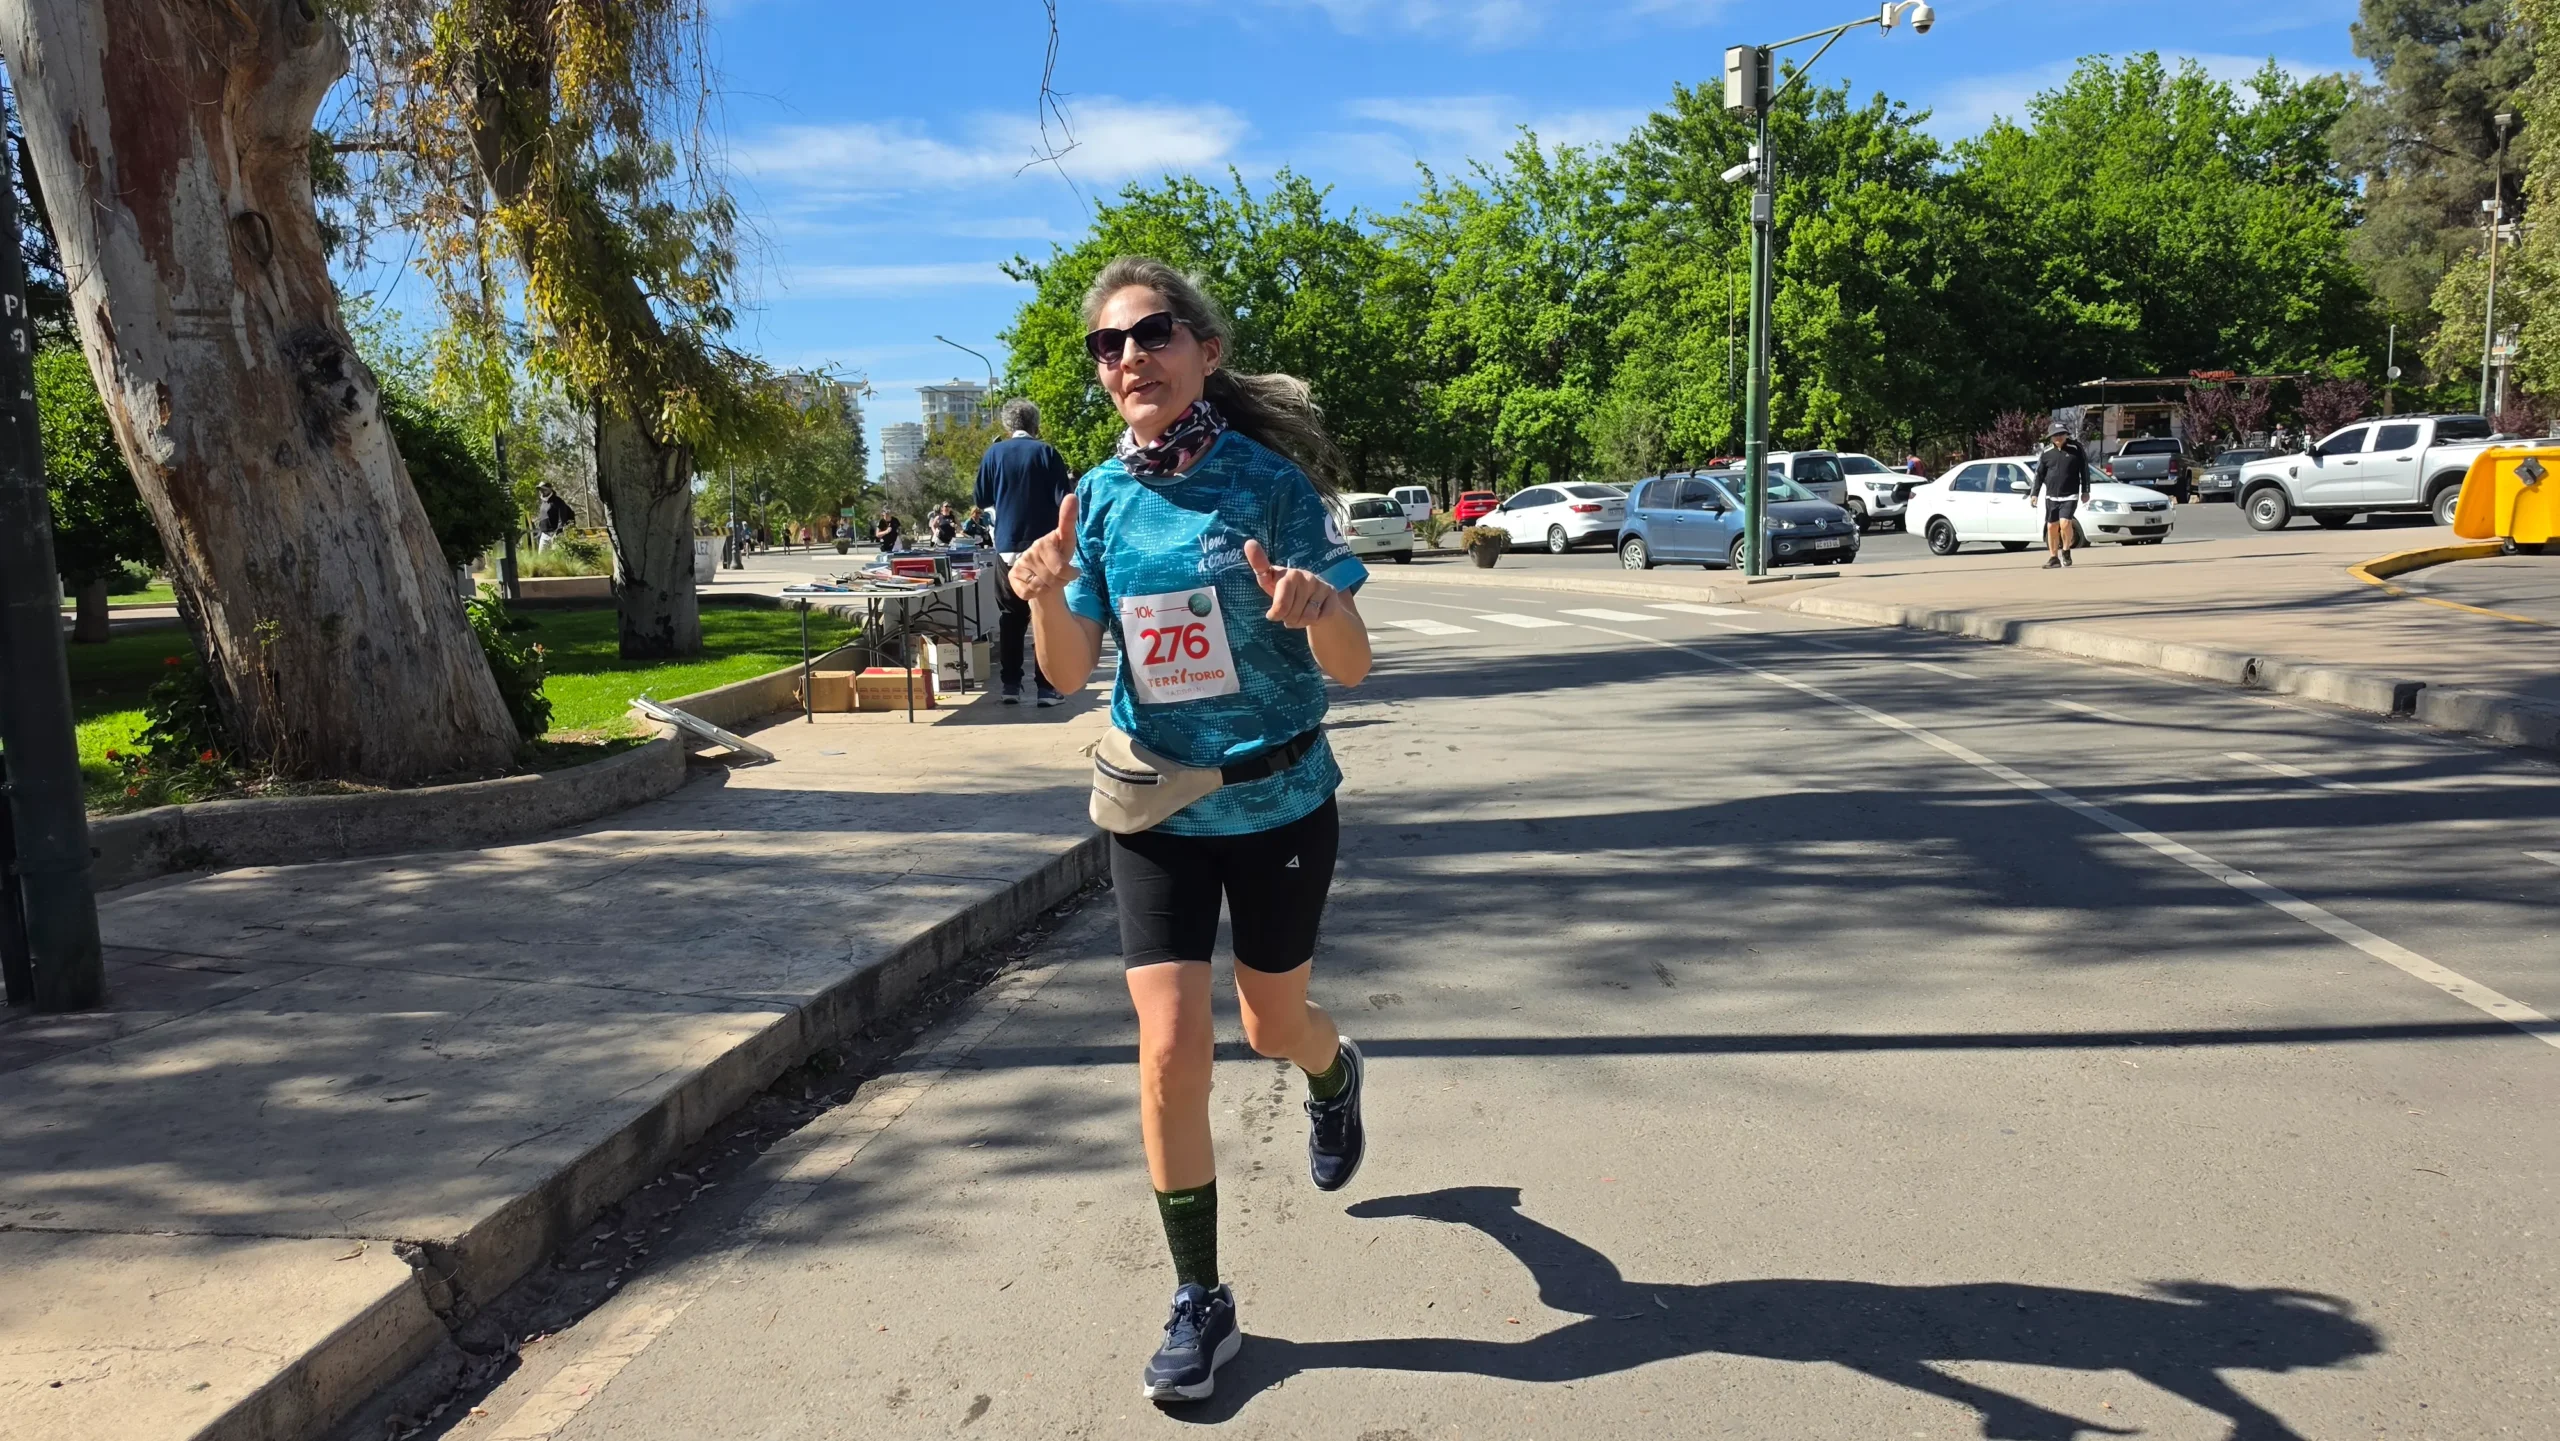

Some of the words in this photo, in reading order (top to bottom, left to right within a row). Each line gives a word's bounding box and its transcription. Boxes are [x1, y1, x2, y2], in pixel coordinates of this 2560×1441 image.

[1197, 557, 1207, 573] a
[1134, 606, 1156, 619] 10k
[1140, 622, 1210, 666] 276
[1147, 668, 1226, 688] TERRITORIO
